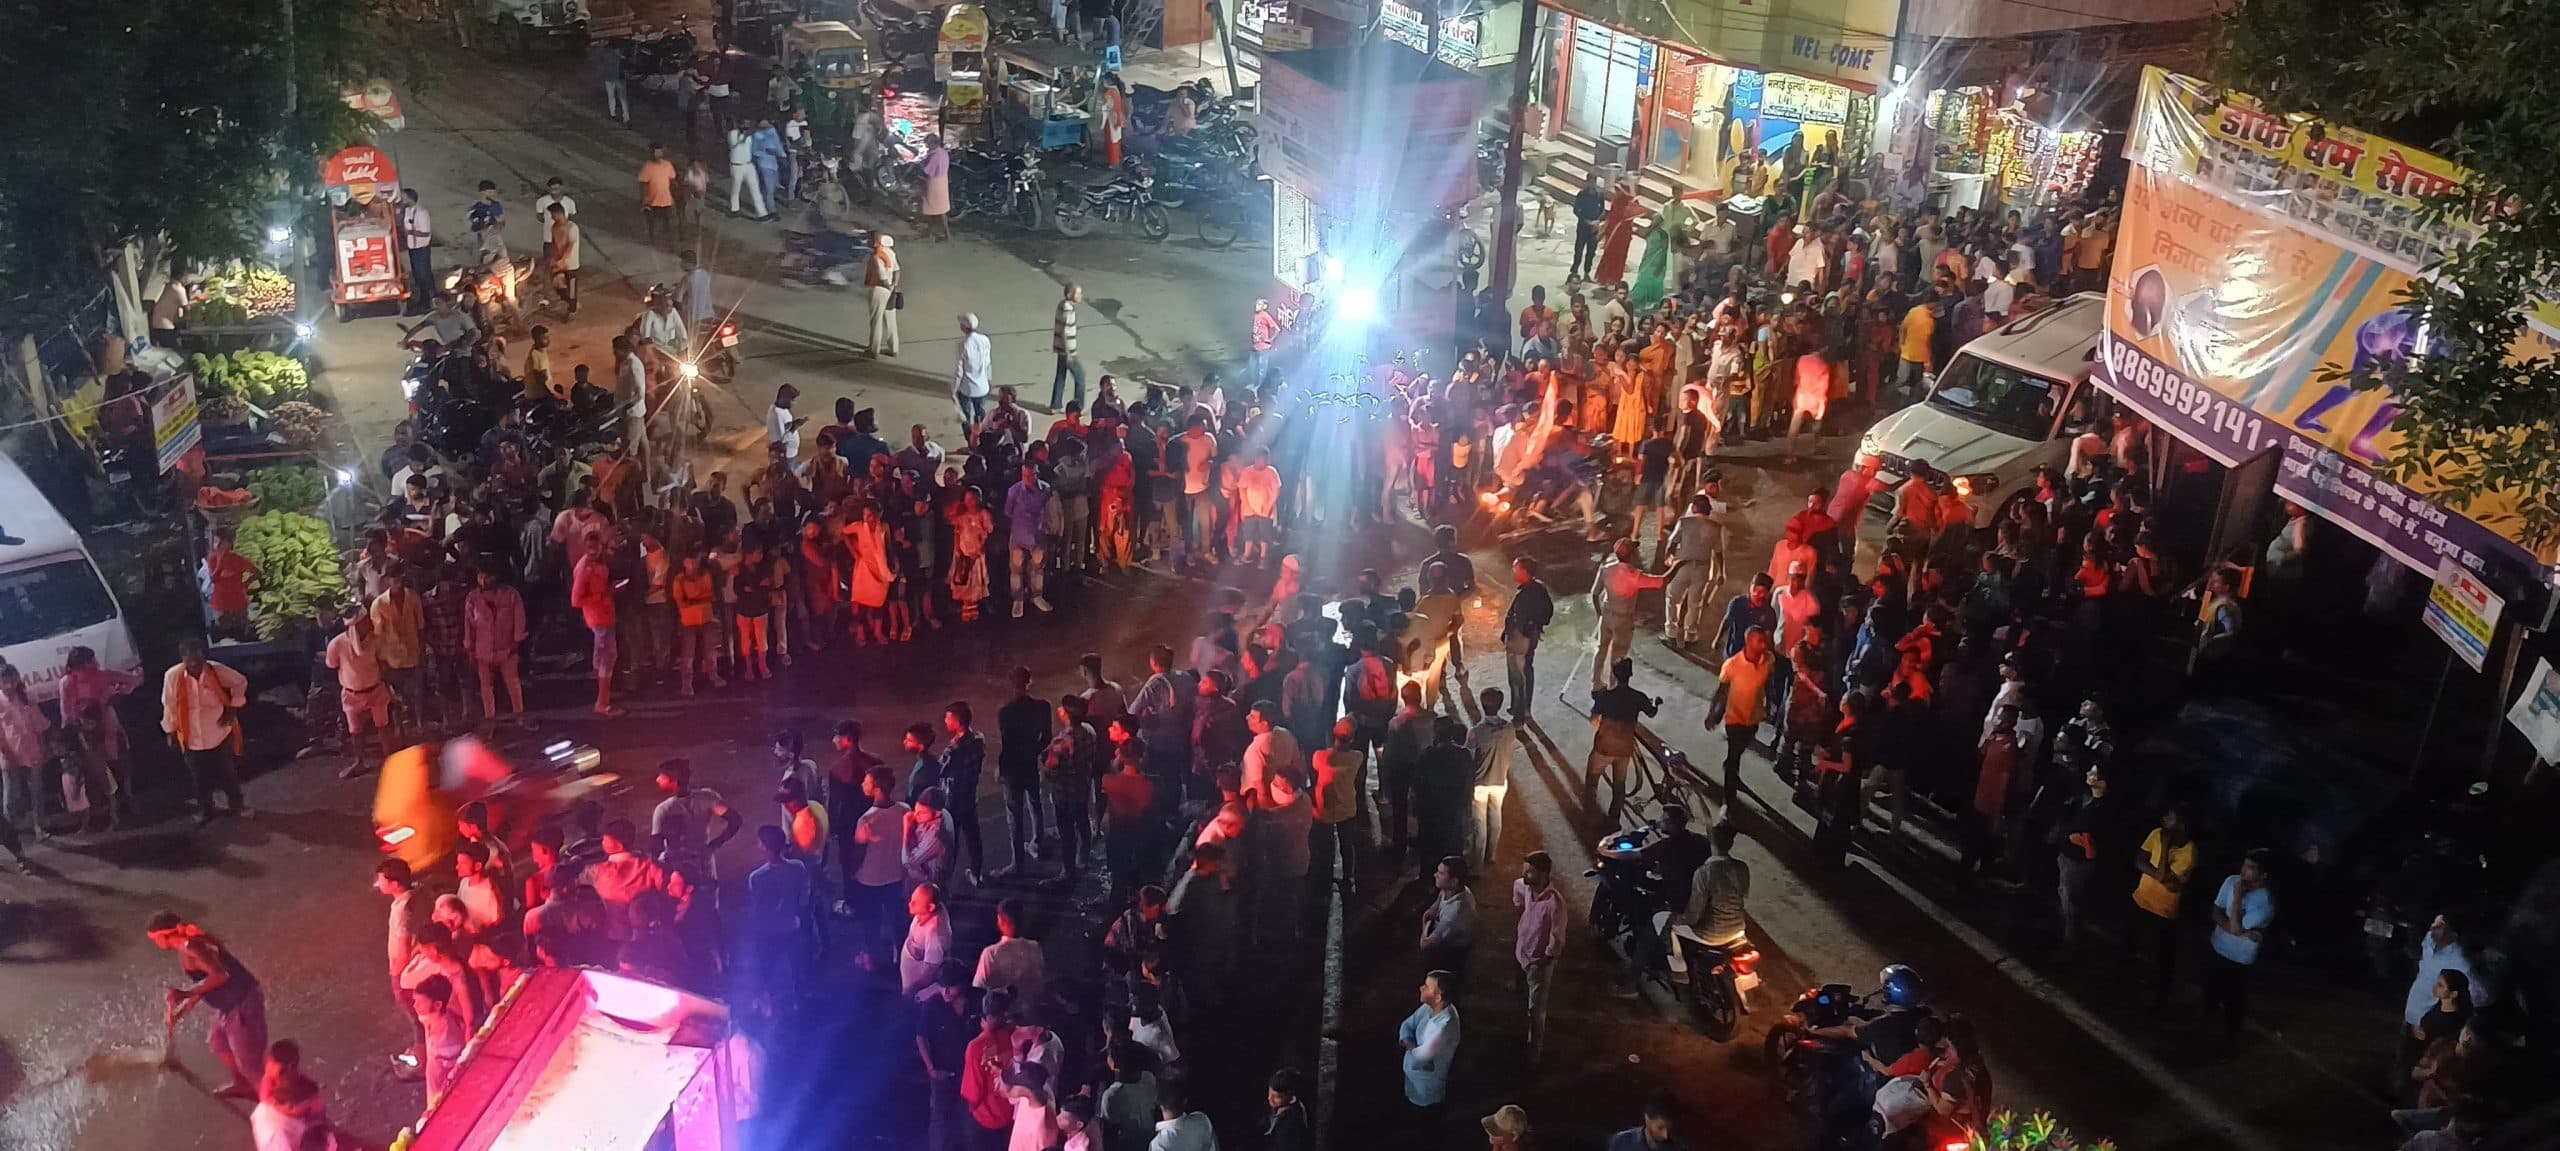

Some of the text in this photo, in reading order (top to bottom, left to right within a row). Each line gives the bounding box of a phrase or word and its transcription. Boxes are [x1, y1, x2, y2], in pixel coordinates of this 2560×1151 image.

[1792, 34, 1874, 71] WEL COME
[1768, 77, 1786, 91] मलाई
[2113, 341, 2263, 452] 8869992141
